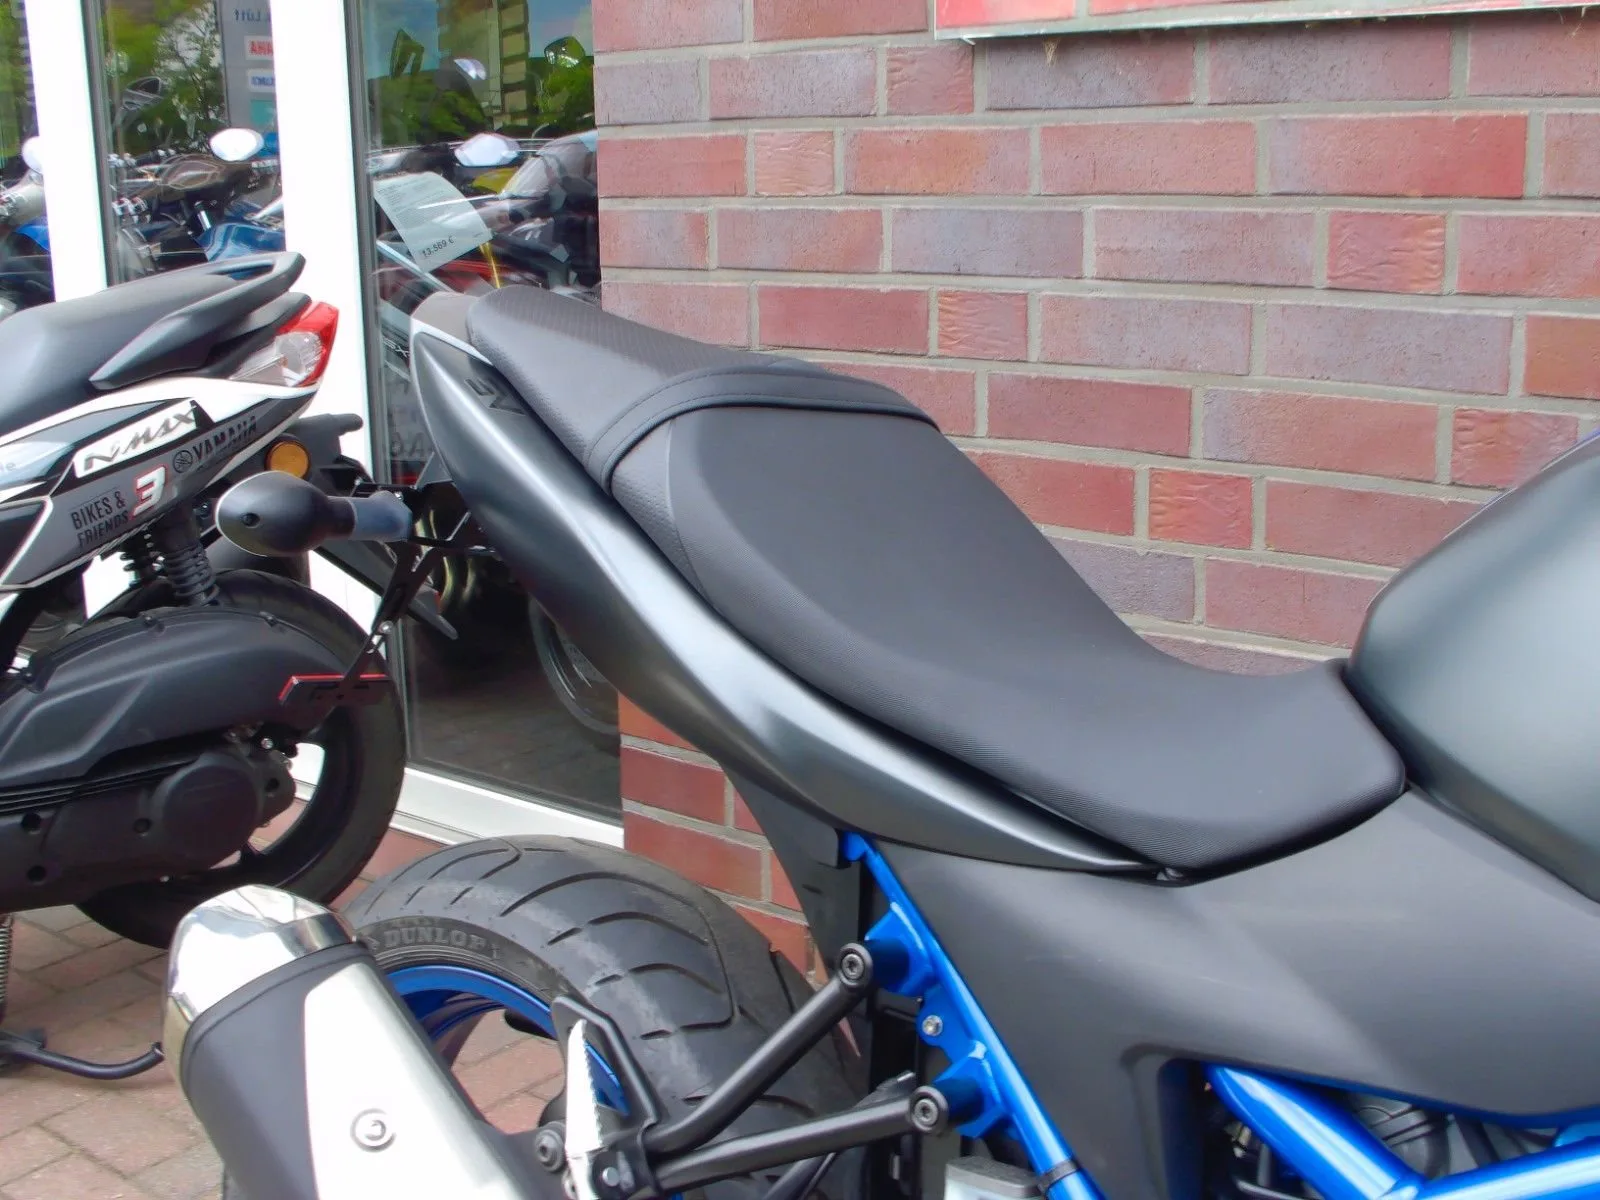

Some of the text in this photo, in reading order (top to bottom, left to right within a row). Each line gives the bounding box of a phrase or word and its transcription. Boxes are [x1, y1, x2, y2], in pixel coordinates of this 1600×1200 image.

[192, 415, 257, 460] YAMAHA
[70, 491, 127, 530] BIKES &
[130, 463, 169, 520] 3
[77, 510, 131, 548] FRIENDS
[383, 926, 487, 950] DUNLOP
